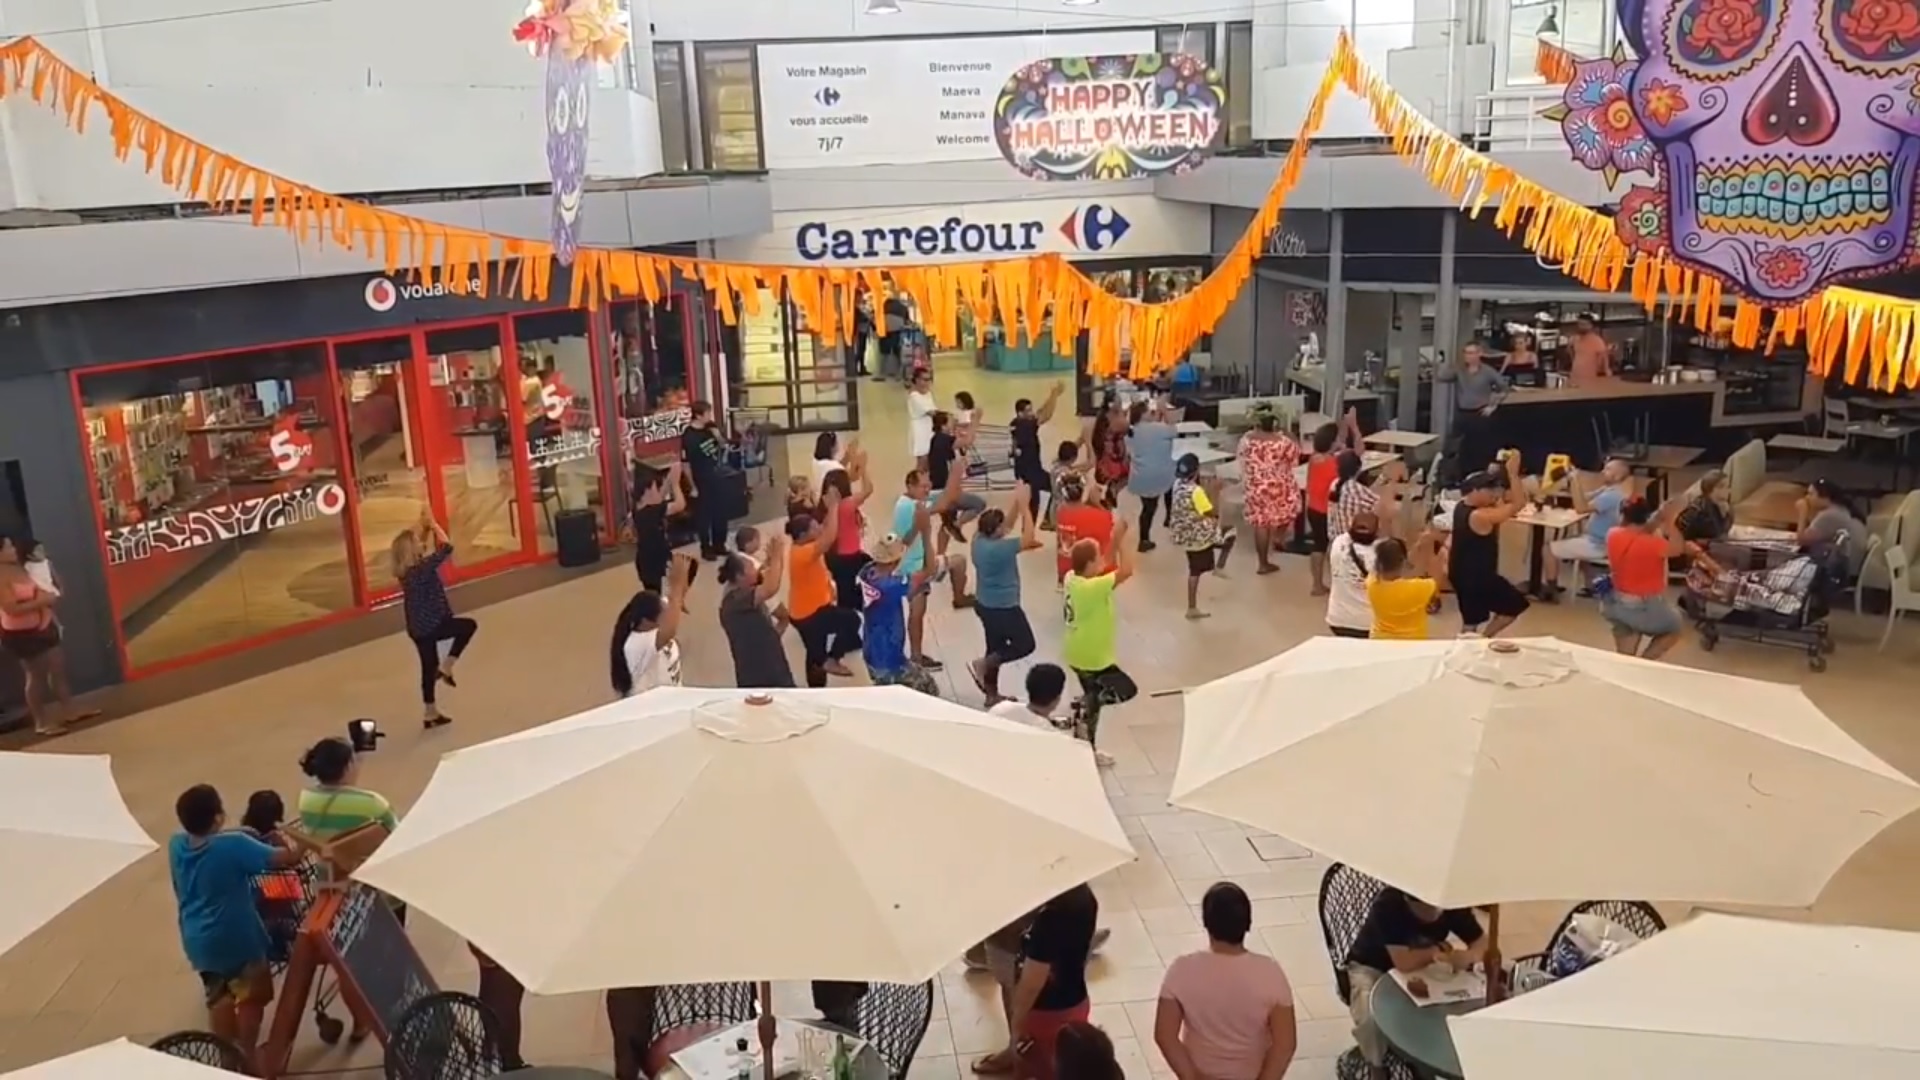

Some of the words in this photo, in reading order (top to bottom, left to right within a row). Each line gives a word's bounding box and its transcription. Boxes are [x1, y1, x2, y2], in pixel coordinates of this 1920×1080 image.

[786, 66, 816, 77] Votre
[819, 65, 867, 78] Magasin
[929, 62, 992, 73] Bienvenue
[942, 86, 981, 96] Maeva
[1050, 81, 1152, 112] HAPPY
[789, 117, 816, 126] vous
[819, 114, 869, 125] accueille
[940, 110, 985, 120] Manava
[1014, 111, 1209, 148] HALLOWEEN
[817, 136, 843, 152] 7j/7
[936, 134, 990, 144] Welcome
[796, 217, 1043, 261] Carrefour
[400, 278, 481, 299] vodane
